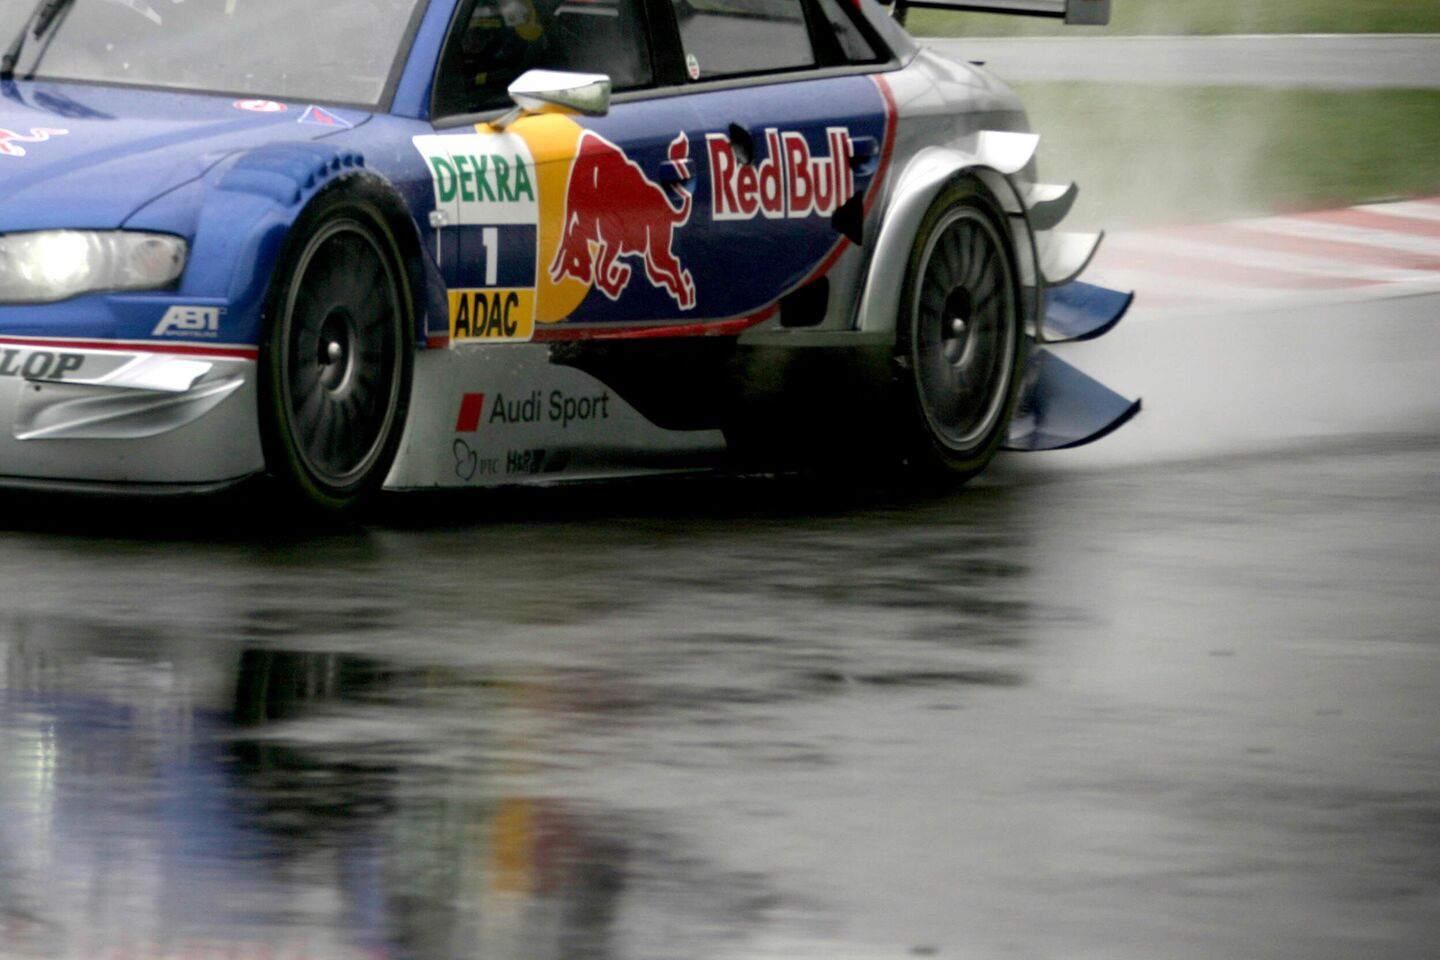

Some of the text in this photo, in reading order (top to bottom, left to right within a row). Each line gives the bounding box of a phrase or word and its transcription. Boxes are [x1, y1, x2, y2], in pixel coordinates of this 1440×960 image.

[429, 153, 535, 204] DEKRA
[706, 127, 854, 219] Red Bull
[481, 226, 498, 287] 1
[151, 304, 220, 337] ABT
[453, 292, 520, 339] ADAC
[489, 389, 610, 429] Audi Sport
